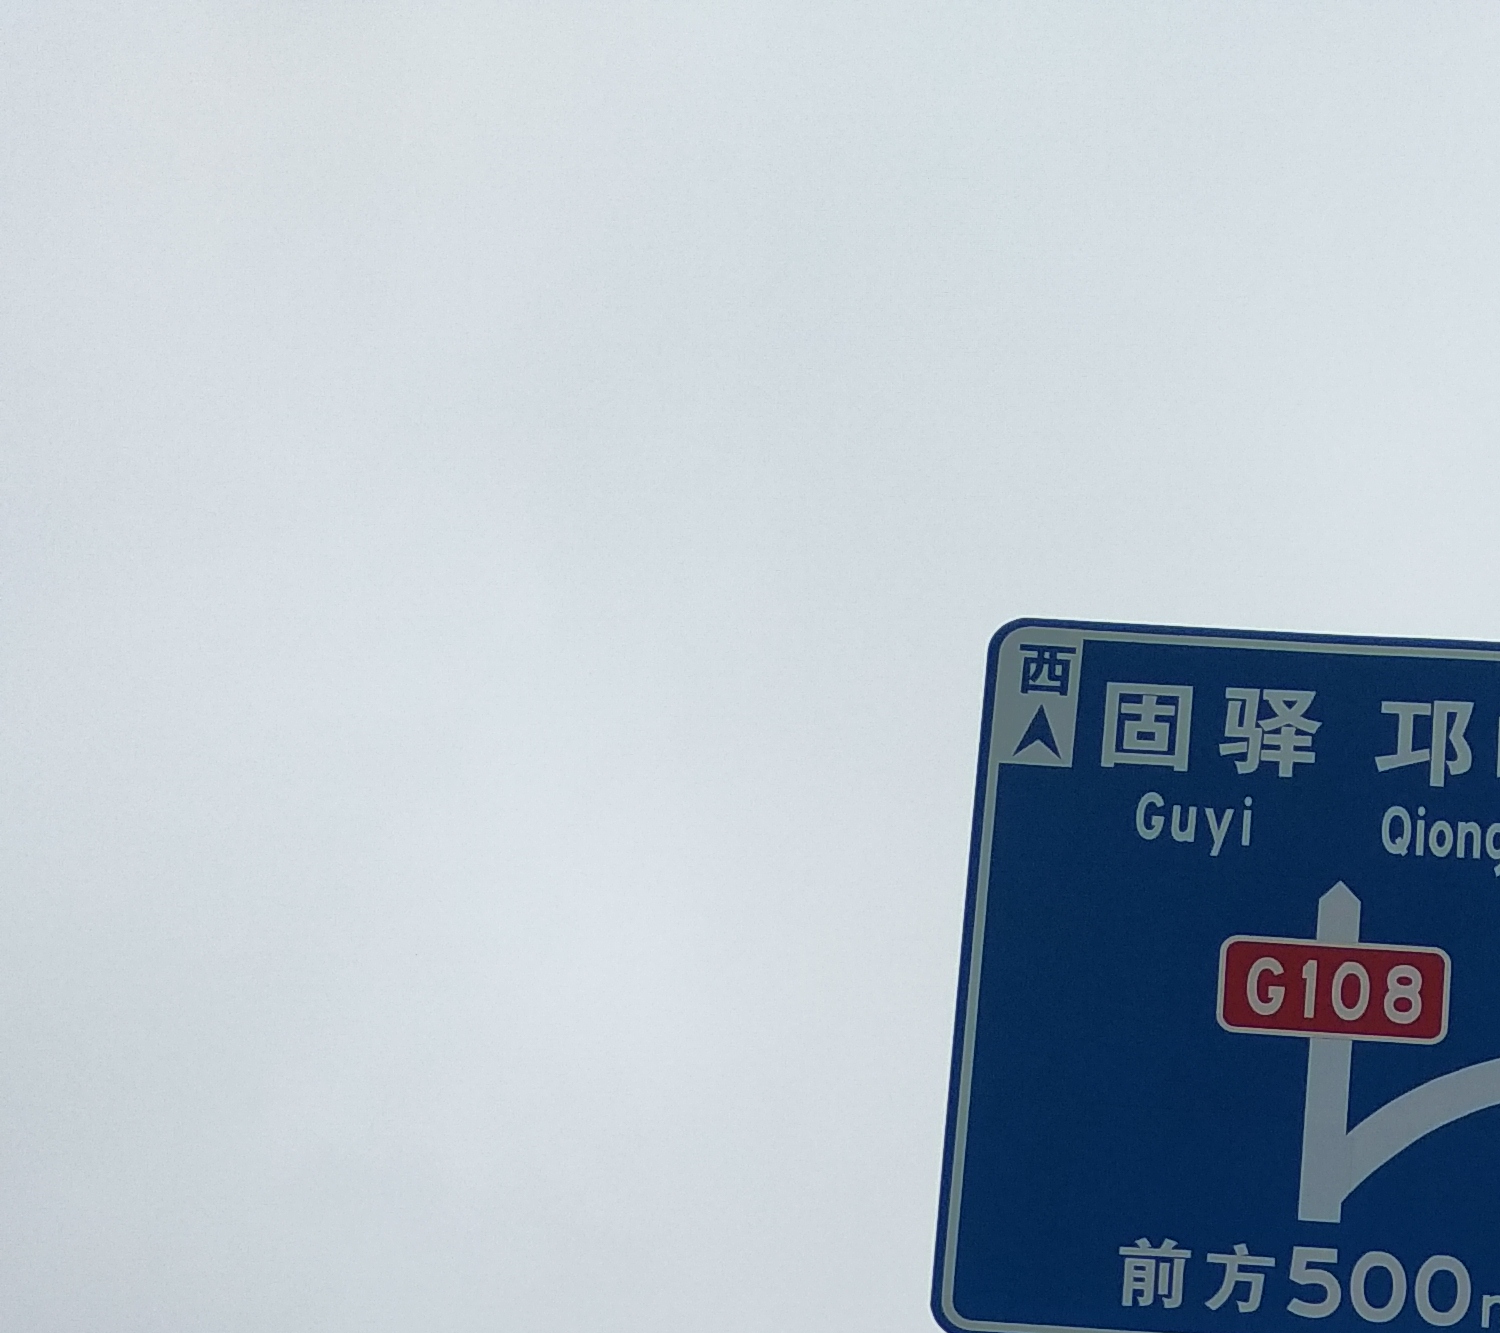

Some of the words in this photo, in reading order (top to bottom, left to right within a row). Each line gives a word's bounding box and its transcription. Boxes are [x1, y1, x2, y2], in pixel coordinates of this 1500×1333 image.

[1019, 643, 1077, 697] 西
[1100, 681, 1322, 778] 固驿
[1135, 791, 1253, 857] Guyi
[1245, 956, 1424, 1027] G108
